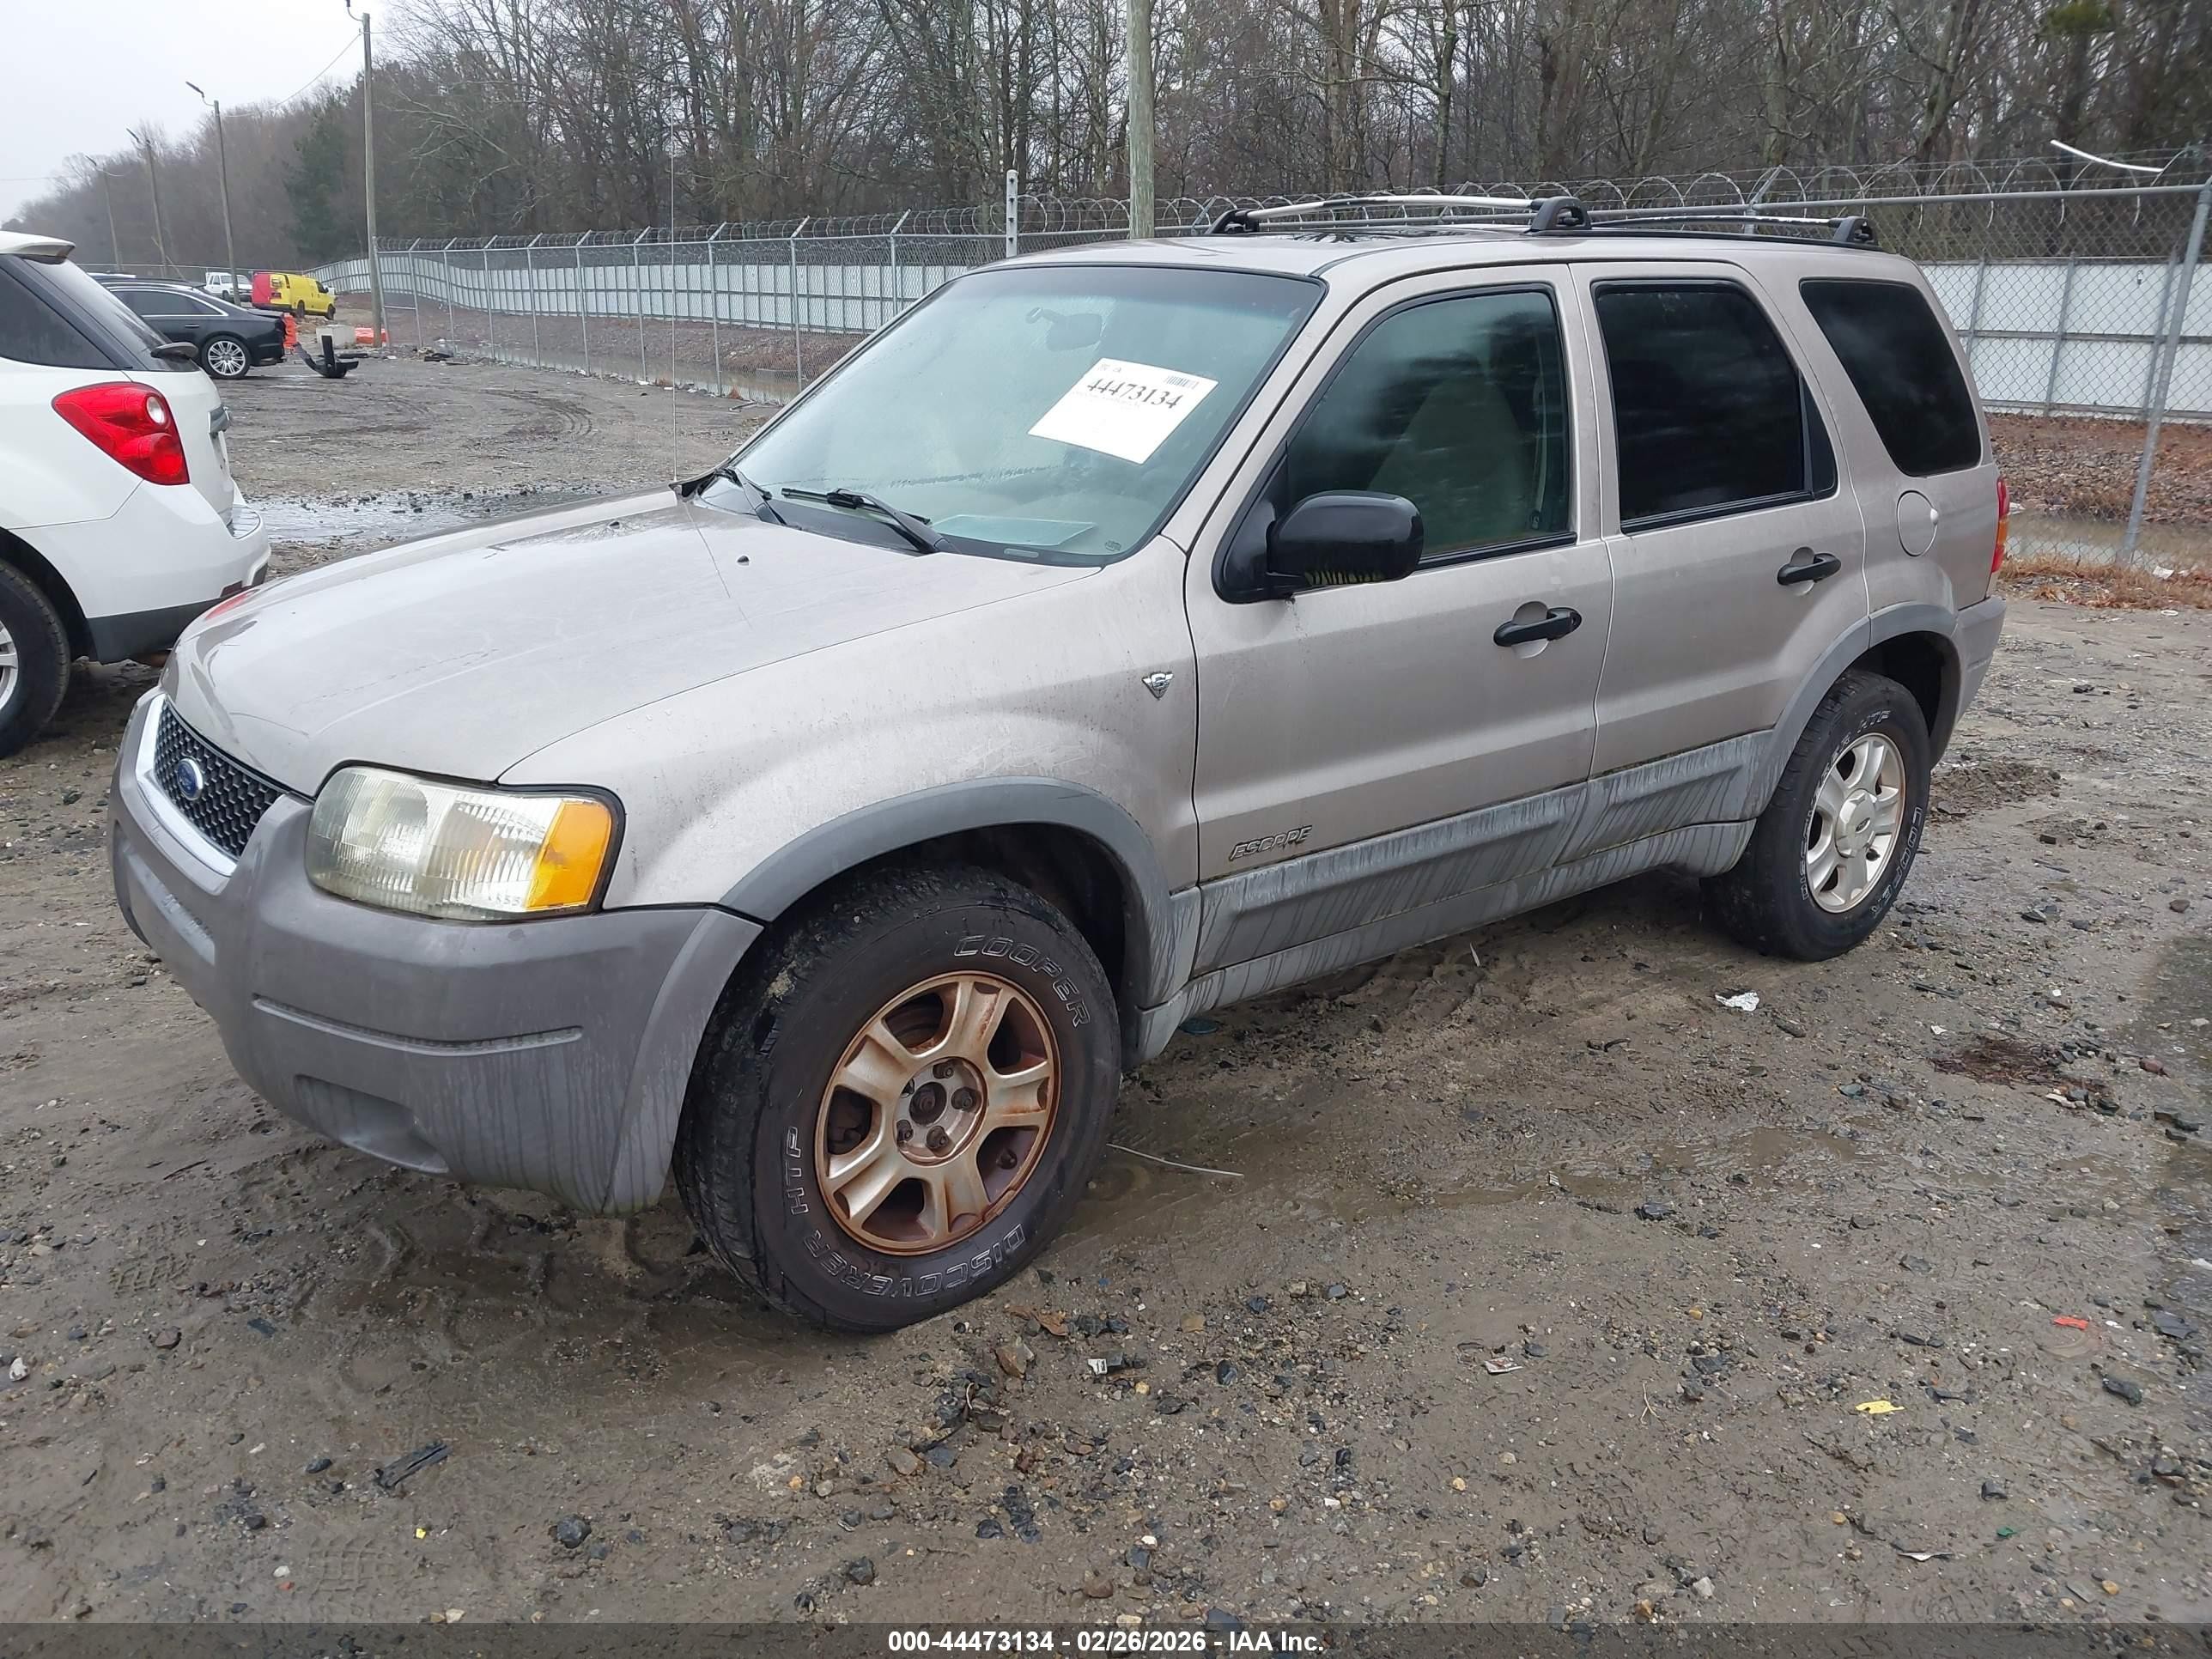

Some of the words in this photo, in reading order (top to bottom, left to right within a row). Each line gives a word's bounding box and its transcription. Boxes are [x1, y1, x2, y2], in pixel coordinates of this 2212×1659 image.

[1086, 378, 1184, 409] 44473134
[1228, 824, 1313, 861] ESCAPE
[953, 934, 1091, 1029] COOPER
[785, 1125, 810, 1216] HTP
[803, 1223, 1026, 1298] DISCOVERER
